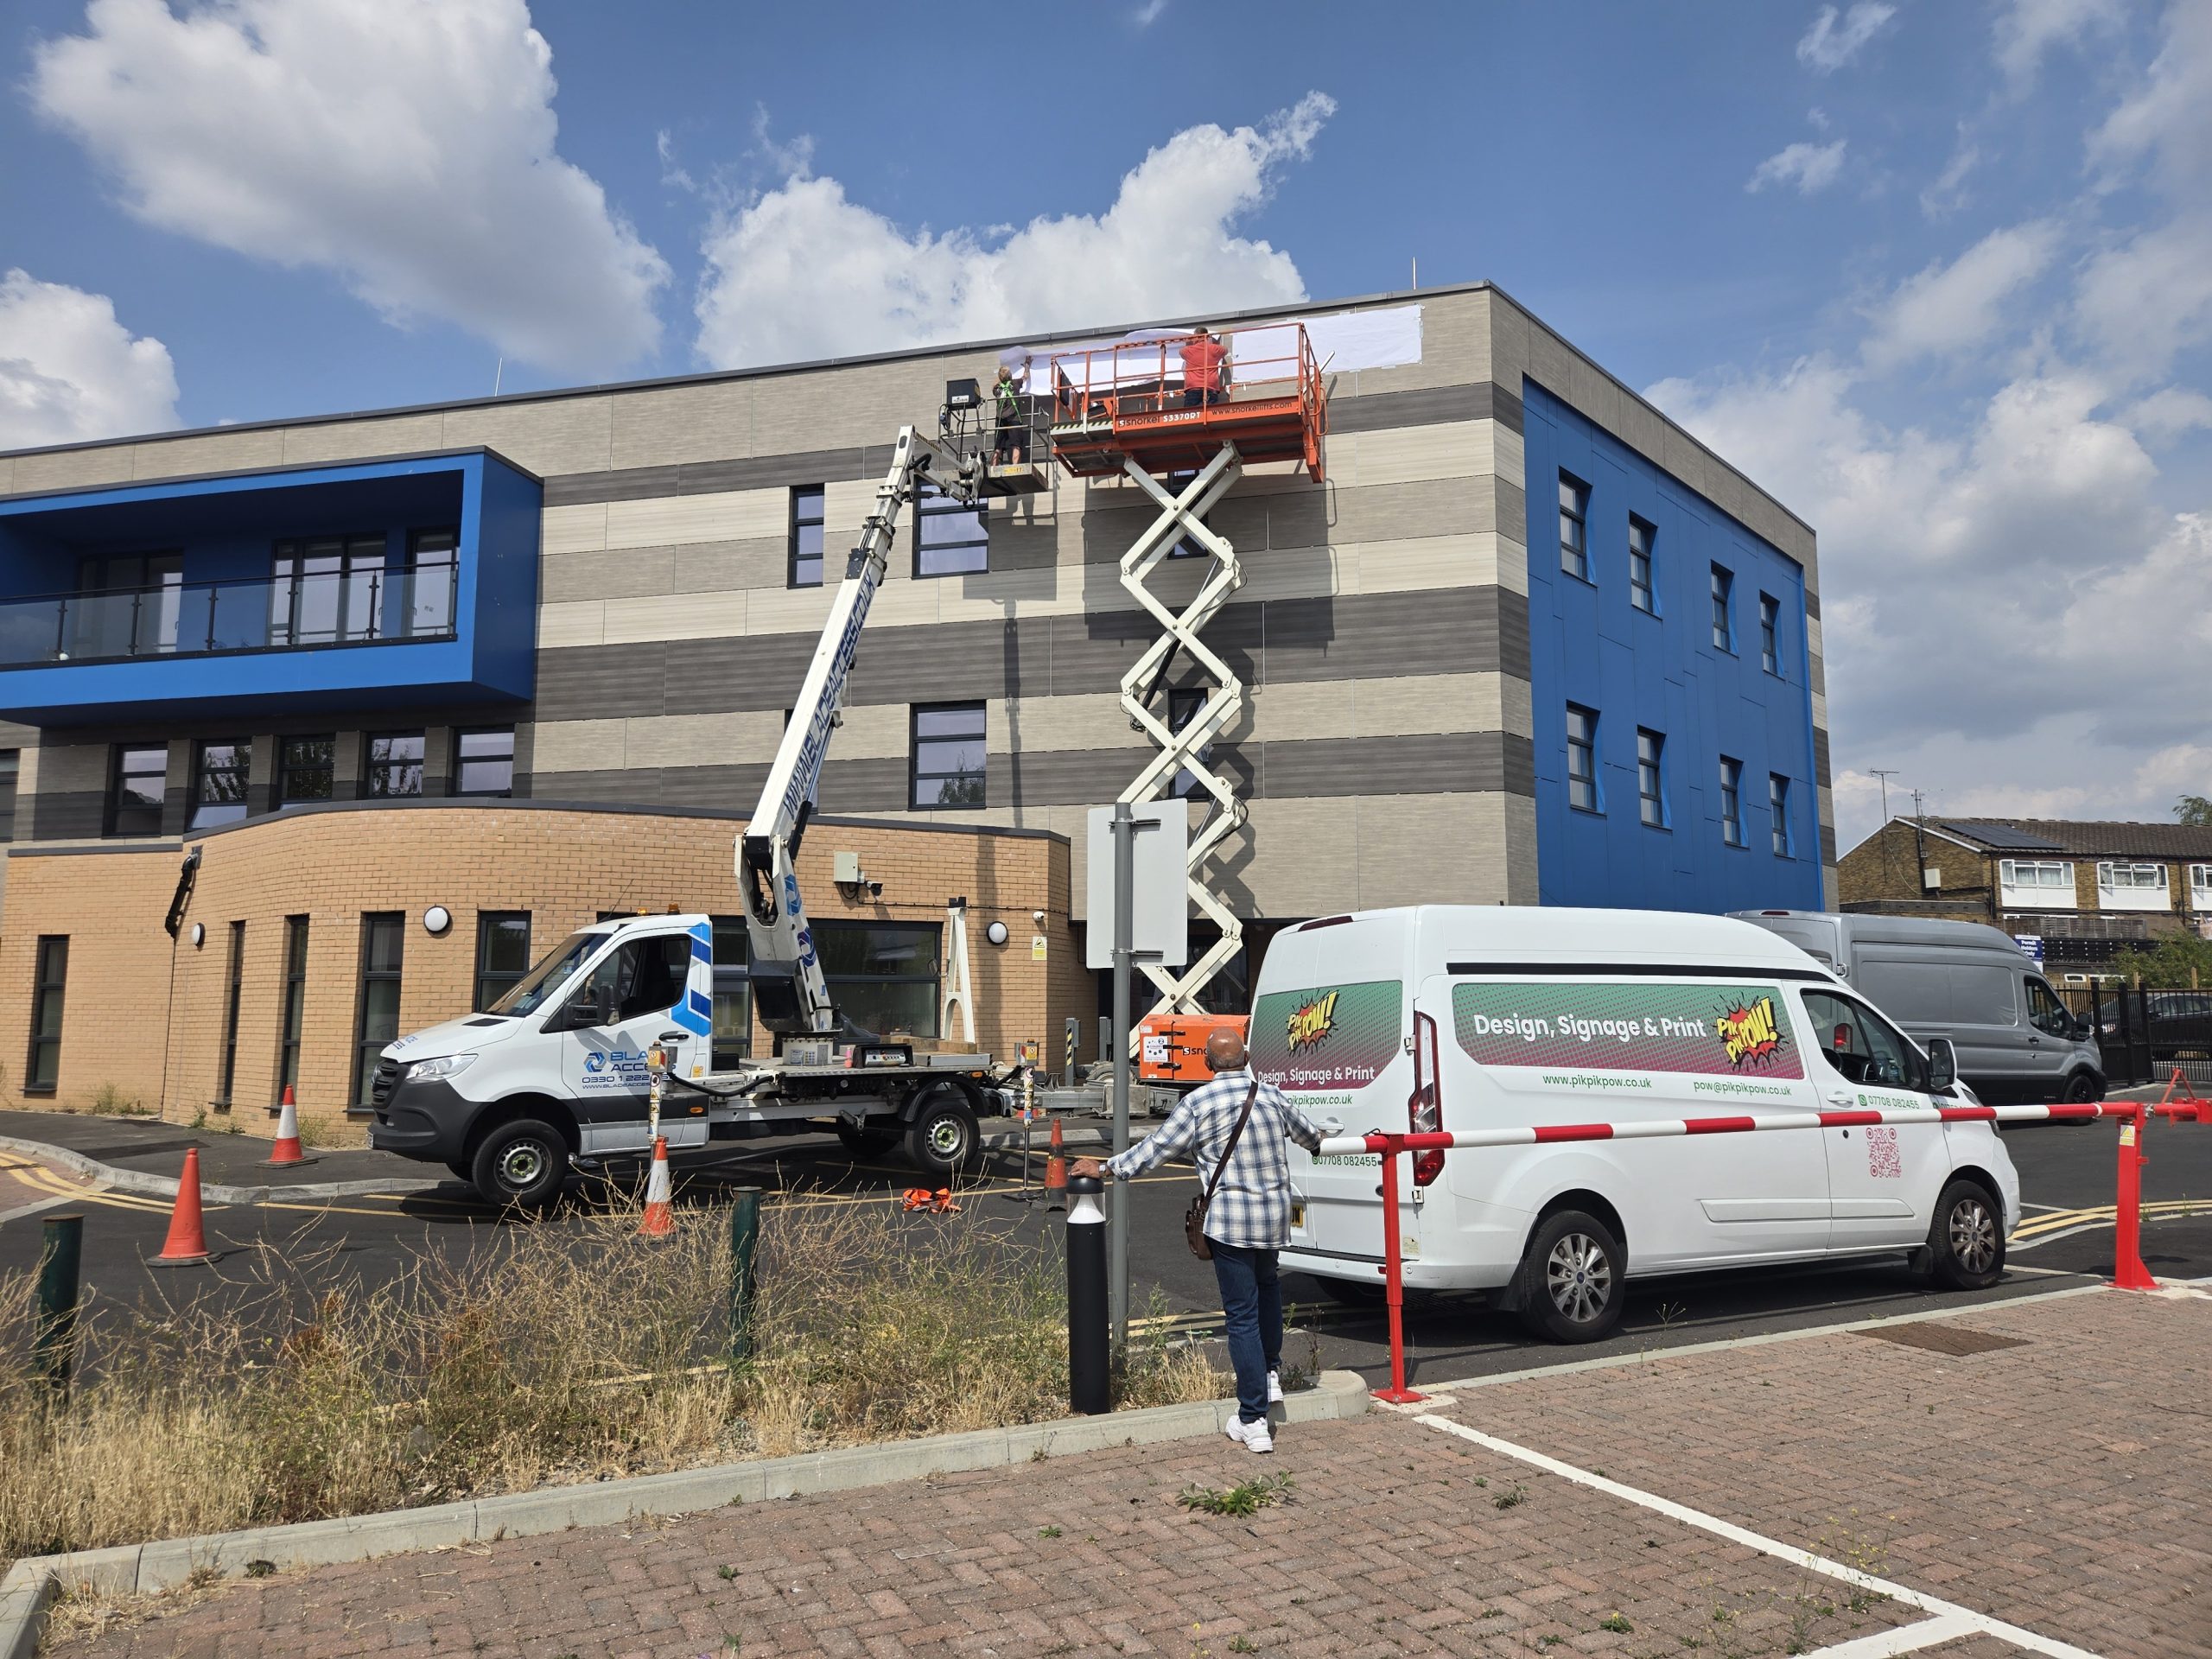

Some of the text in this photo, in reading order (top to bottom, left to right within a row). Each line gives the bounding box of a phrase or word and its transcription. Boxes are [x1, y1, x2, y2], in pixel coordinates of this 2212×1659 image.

[1211, 402, 1293, 416] www.snorkellifts.com
[1125, 415, 1160, 426] snorkel
[1163, 411, 1201, 423] S3370RT
[1473, 1012, 1707, 1043] Design, Signage & Print
[1716, 1018, 1738, 1037] PIK
[1738, 996, 1777, 1048] POW!
[610, 1051, 649, 1062] BLA
[1257, 1065, 1376, 1086] Design, Signage & Print
[1542, 1074, 1652, 1090] www.pikpikpow.co.uk
[1694, 1079, 1792, 1096] pow@pikpikpow.co.uk
[1287, 1094, 1353, 1109] pikpikpow.co.uk
[1868, 1096, 1920, 1109] 07708 082455
[1318, 1155, 1377, 1166] 07708 082455
